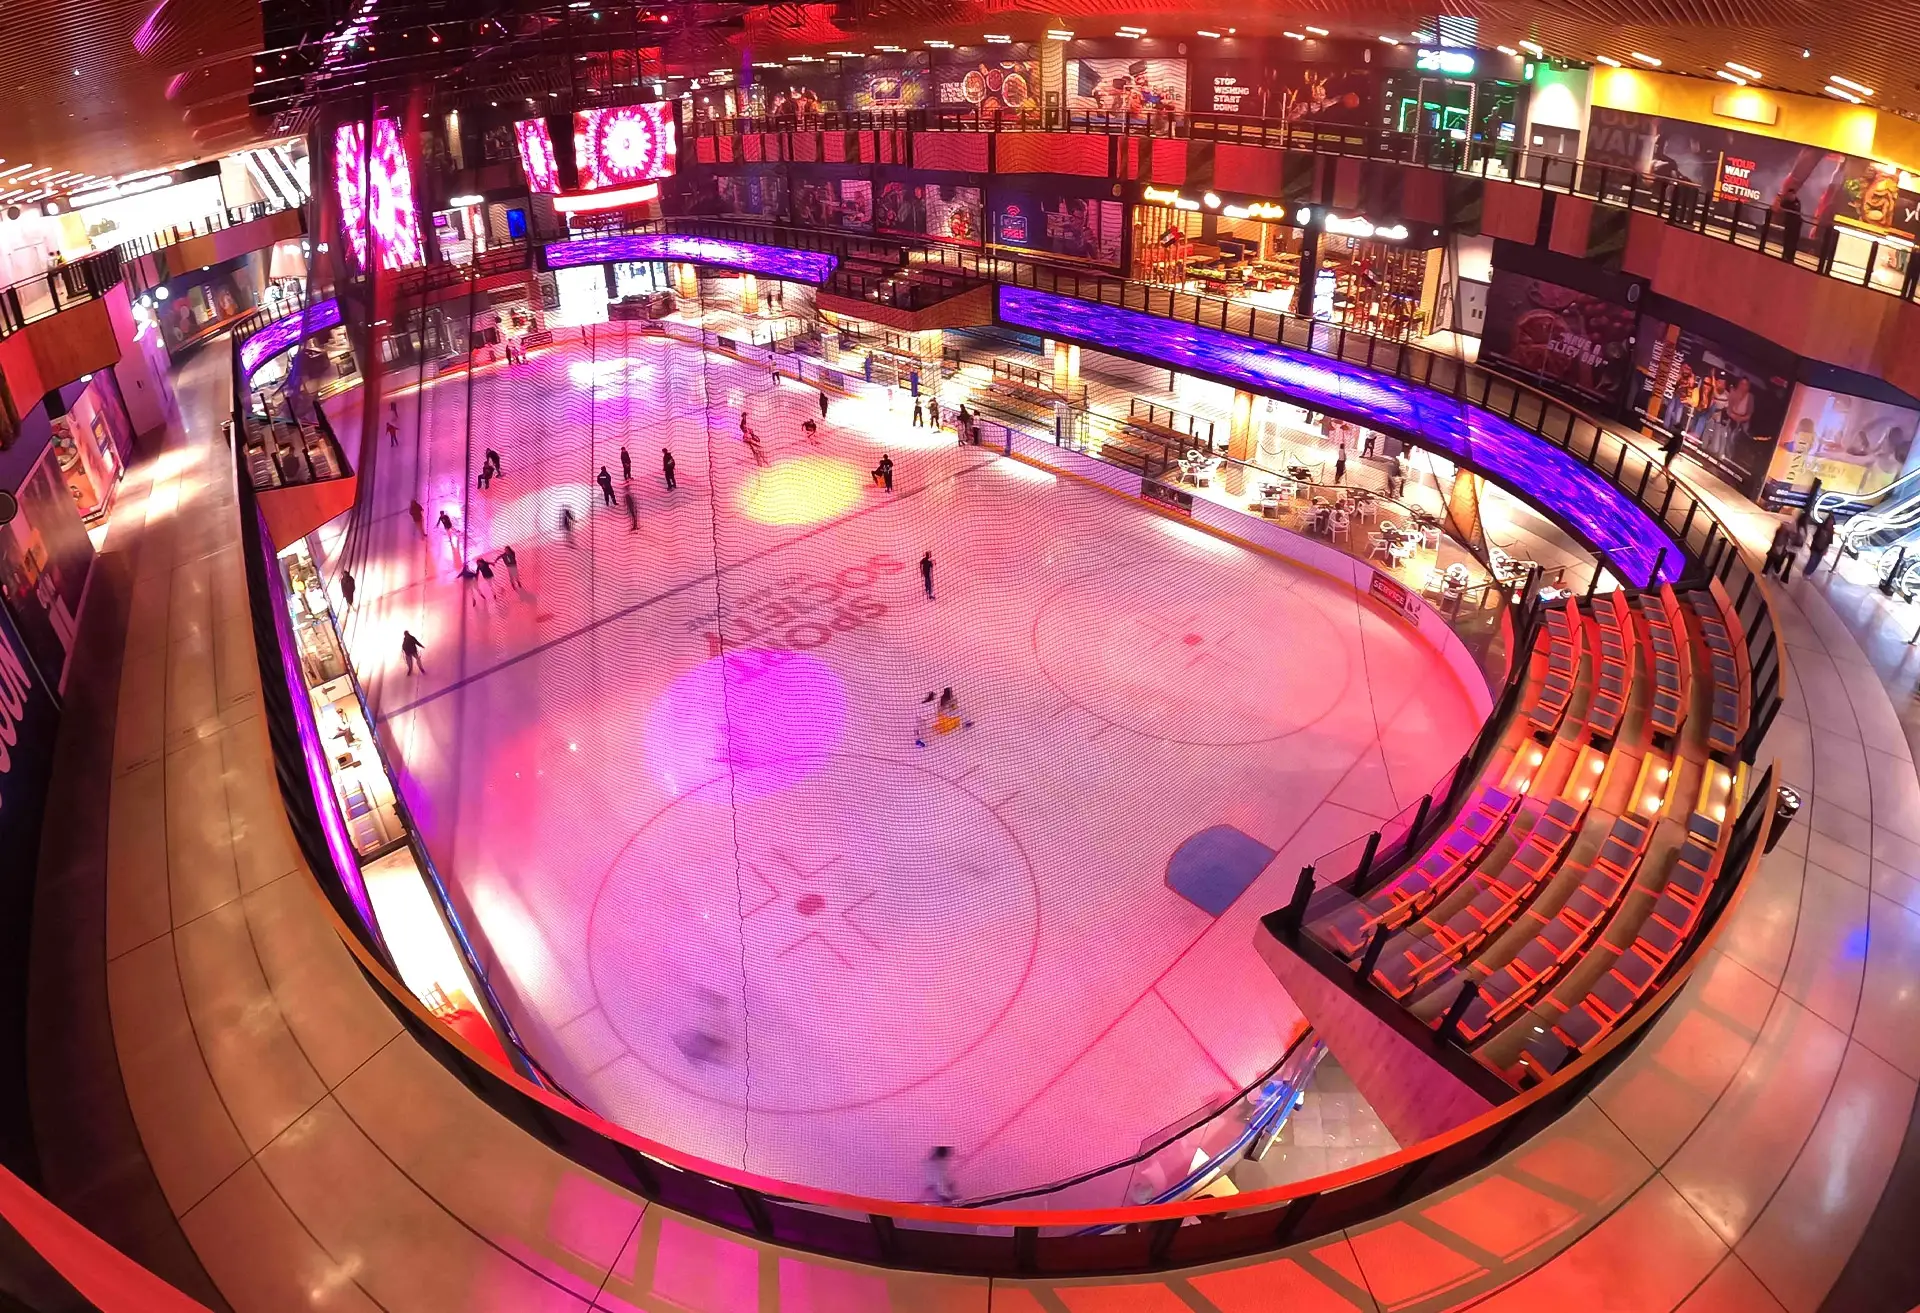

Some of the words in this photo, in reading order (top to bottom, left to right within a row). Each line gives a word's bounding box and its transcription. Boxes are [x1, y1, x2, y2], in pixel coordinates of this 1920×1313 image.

[1214, 77, 1236, 86] STOP
[1214, 86, 1250, 95] WISHING
[1213, 95, 1241, 103] START
[1213, 103, 1239, 112] DOING
[1724, 165, 1751, 179] WAIT
[1721, 183, 1761, 200] GETTING
[1651, 339, 1664, 362] HERE
[1648, 361, 1659, 379] ARE
[1663, 349, 1685, 400] EXPERIENCE
[1643, 377, 1655, 392] WE
[1373, 579, 1405, 605] SERVICE
